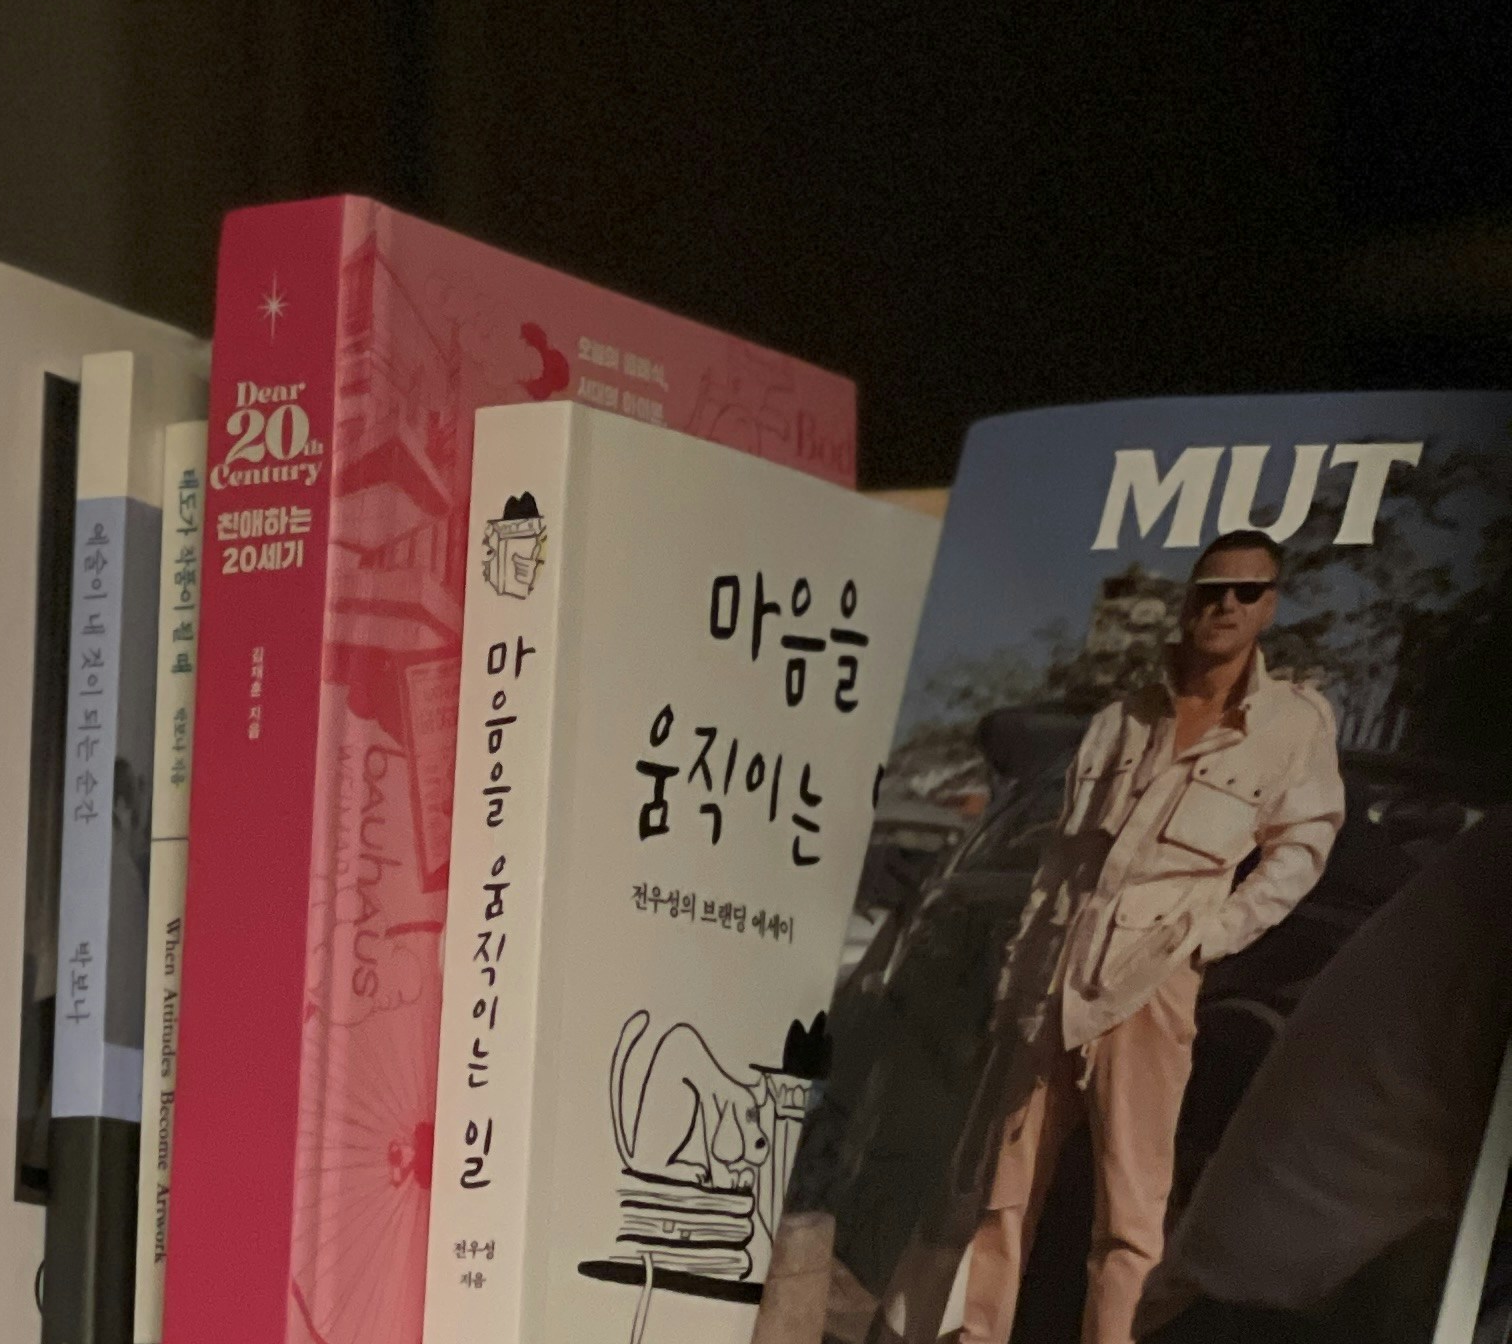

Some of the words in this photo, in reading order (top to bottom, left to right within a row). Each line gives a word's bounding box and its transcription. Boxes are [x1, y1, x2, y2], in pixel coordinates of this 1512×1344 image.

[236, 381, 306, 407] Dear
[226, 405, 324, 466] 20th
[208, 460, 323, 491] Century
[1090, 441, 1425, 551] MUT
[216, 506, 313, 542] 친애하는
[83, 522, 109, 601] 예술이
[221, 540, 306, 575] 20세기
[82, 610, 106, 637] 내
[708, 570, 869, 713] 마음을
[80, 648, 105, 698] 것이
[75, 709, 103, 762] 되는
[483, 635, 536, 827] 마음을
[73, 770, 100, 826] 순간
[635, 703, 823, 867] 움직이는
[631, 882, 696, 921] 전우성의
[699, 899, 747, 934] 브랜딩
[751, 909, 795, 945] 에세이
[164, 918, 182, 976] When
[467, 856, 510, 1088] 움직이는
[161, 988, 179, 1079] Attitudes
[159, 1090, 175, 1172] Become
[459, 1119, 491, 1189] 일
[154, 1184, 171, 1265] Artwork
[453, 1240, 497, 1261] 전우성
[460, 1271, 487, 1290] 지음
